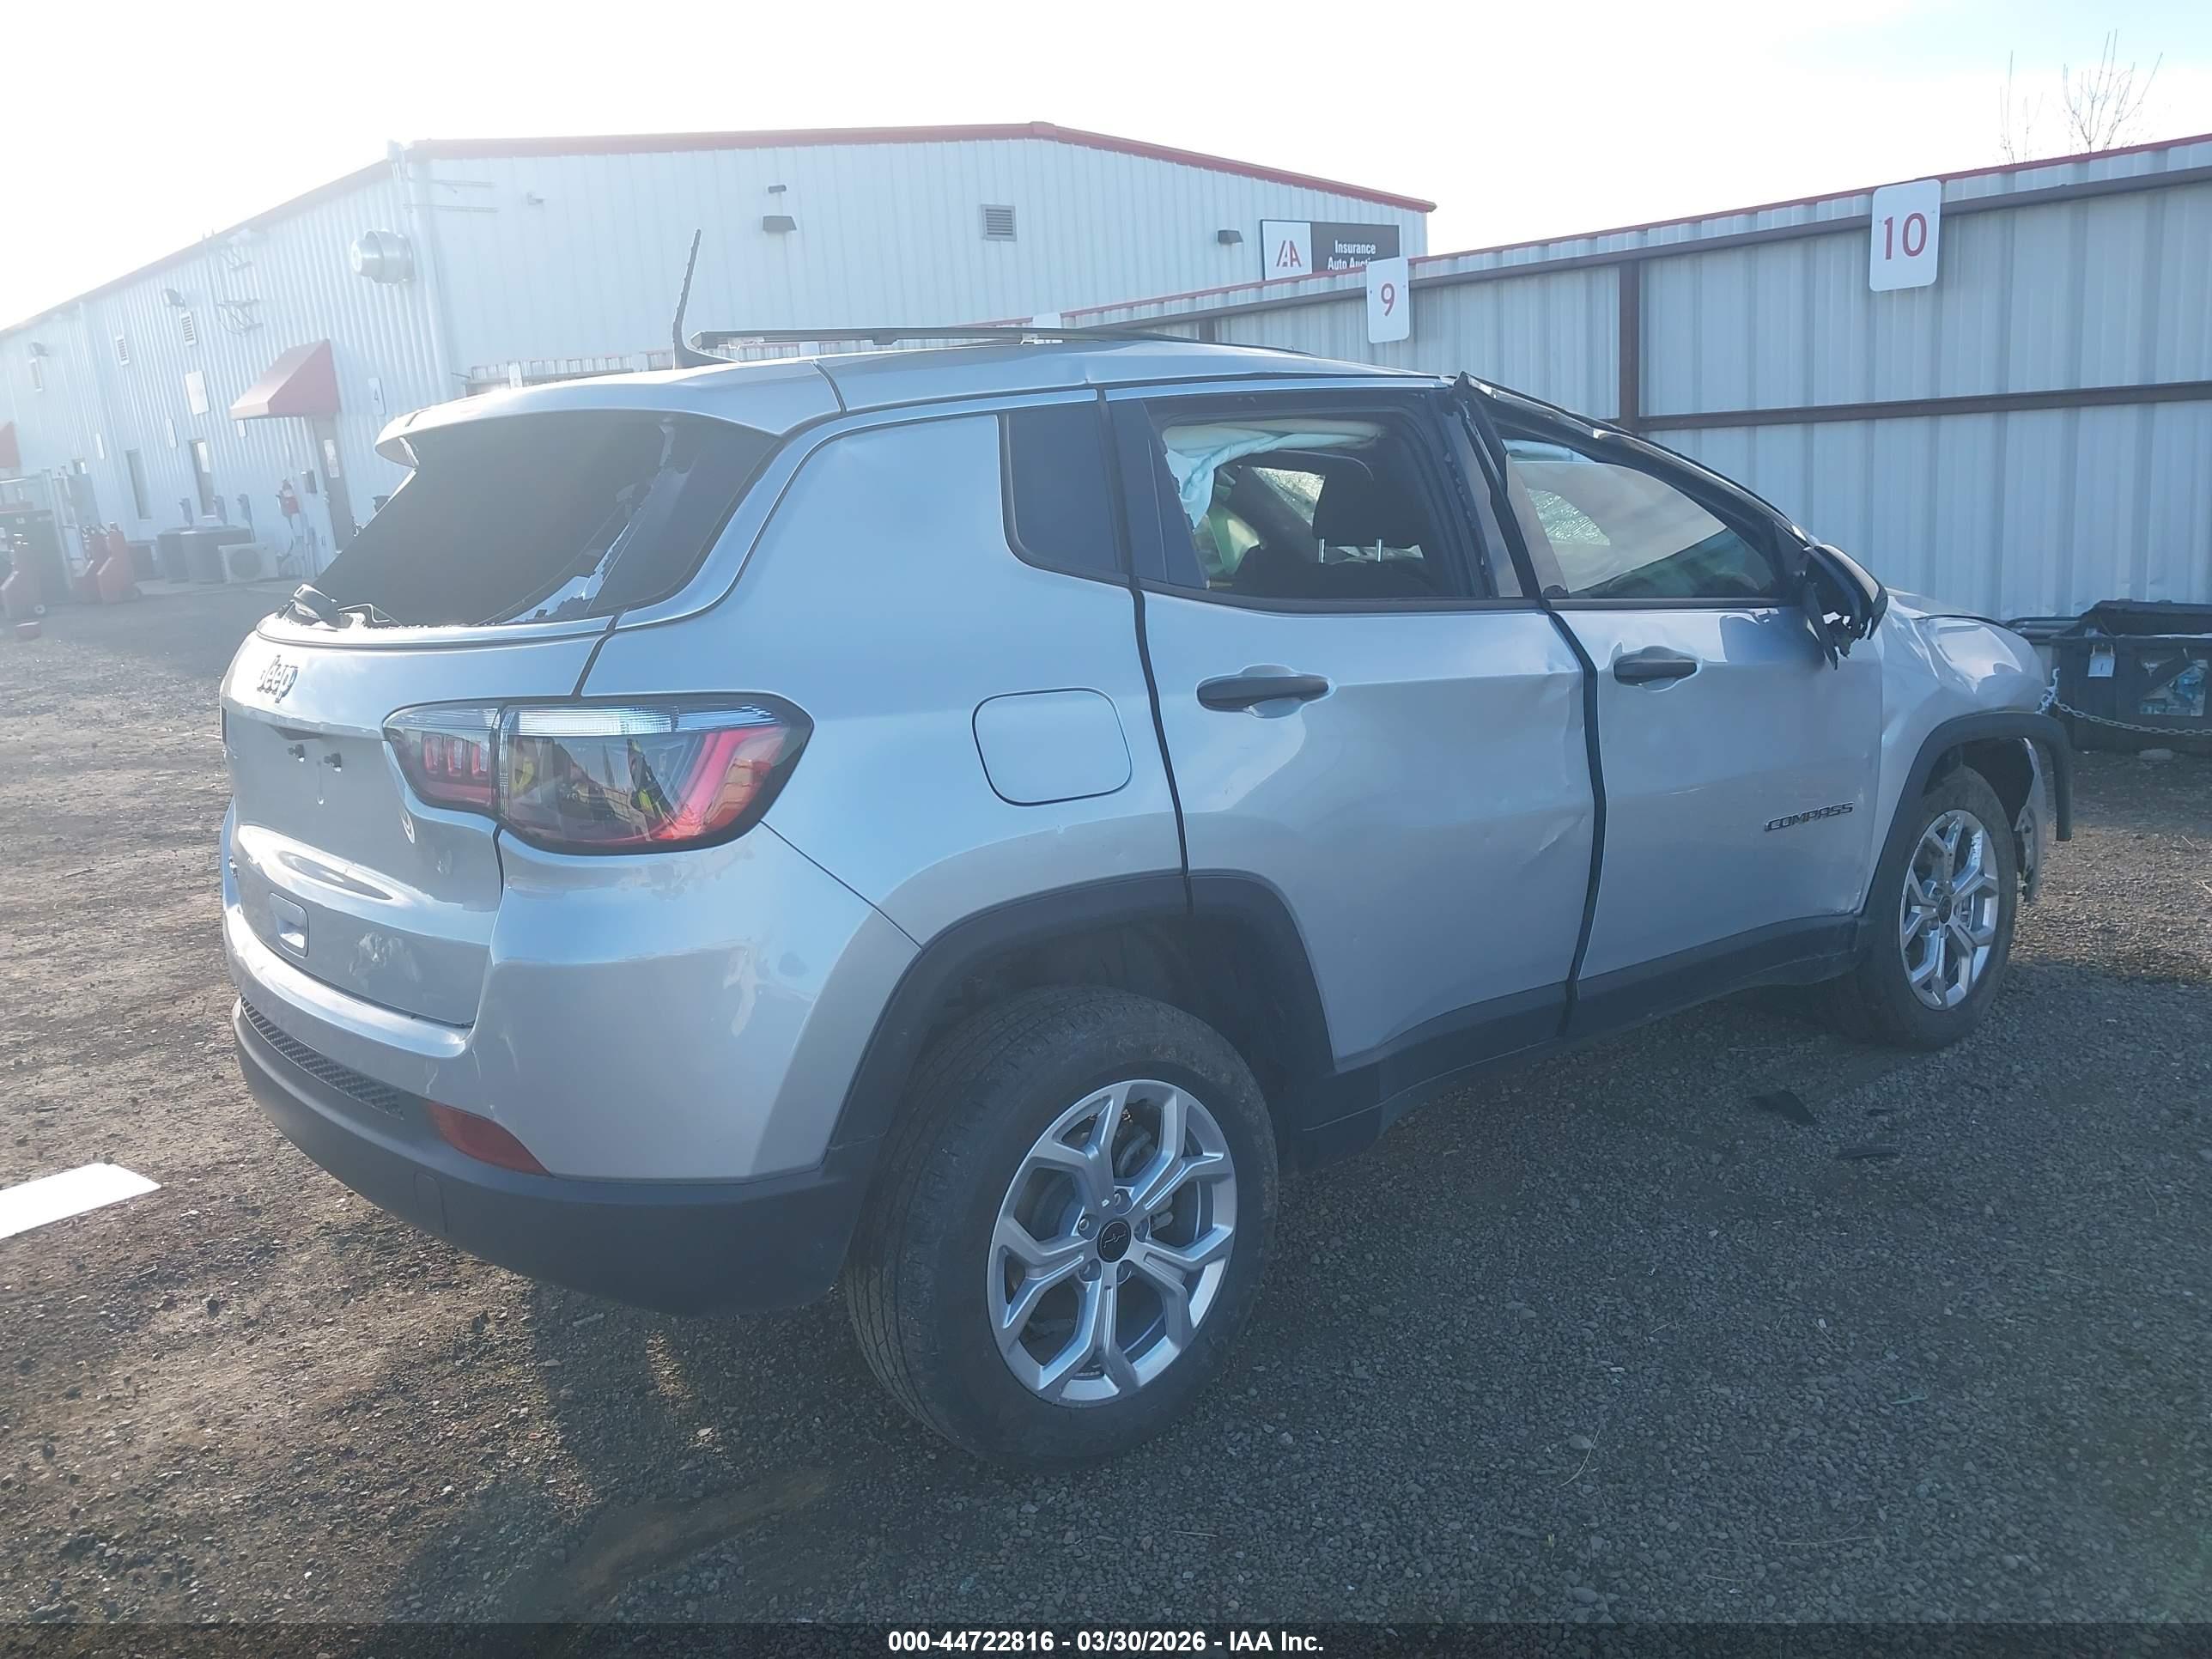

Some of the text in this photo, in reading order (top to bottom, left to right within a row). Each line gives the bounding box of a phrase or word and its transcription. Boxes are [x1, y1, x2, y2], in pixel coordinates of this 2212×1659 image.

[1334, 240, 1376, 255] Insurance
[1884, 213, 1927, 260] 10
[1328, 257, 1347, 270] Auto
[1381, 283, 1395, 317] 9
[1765, 801, 1855, 832] COMPASS
